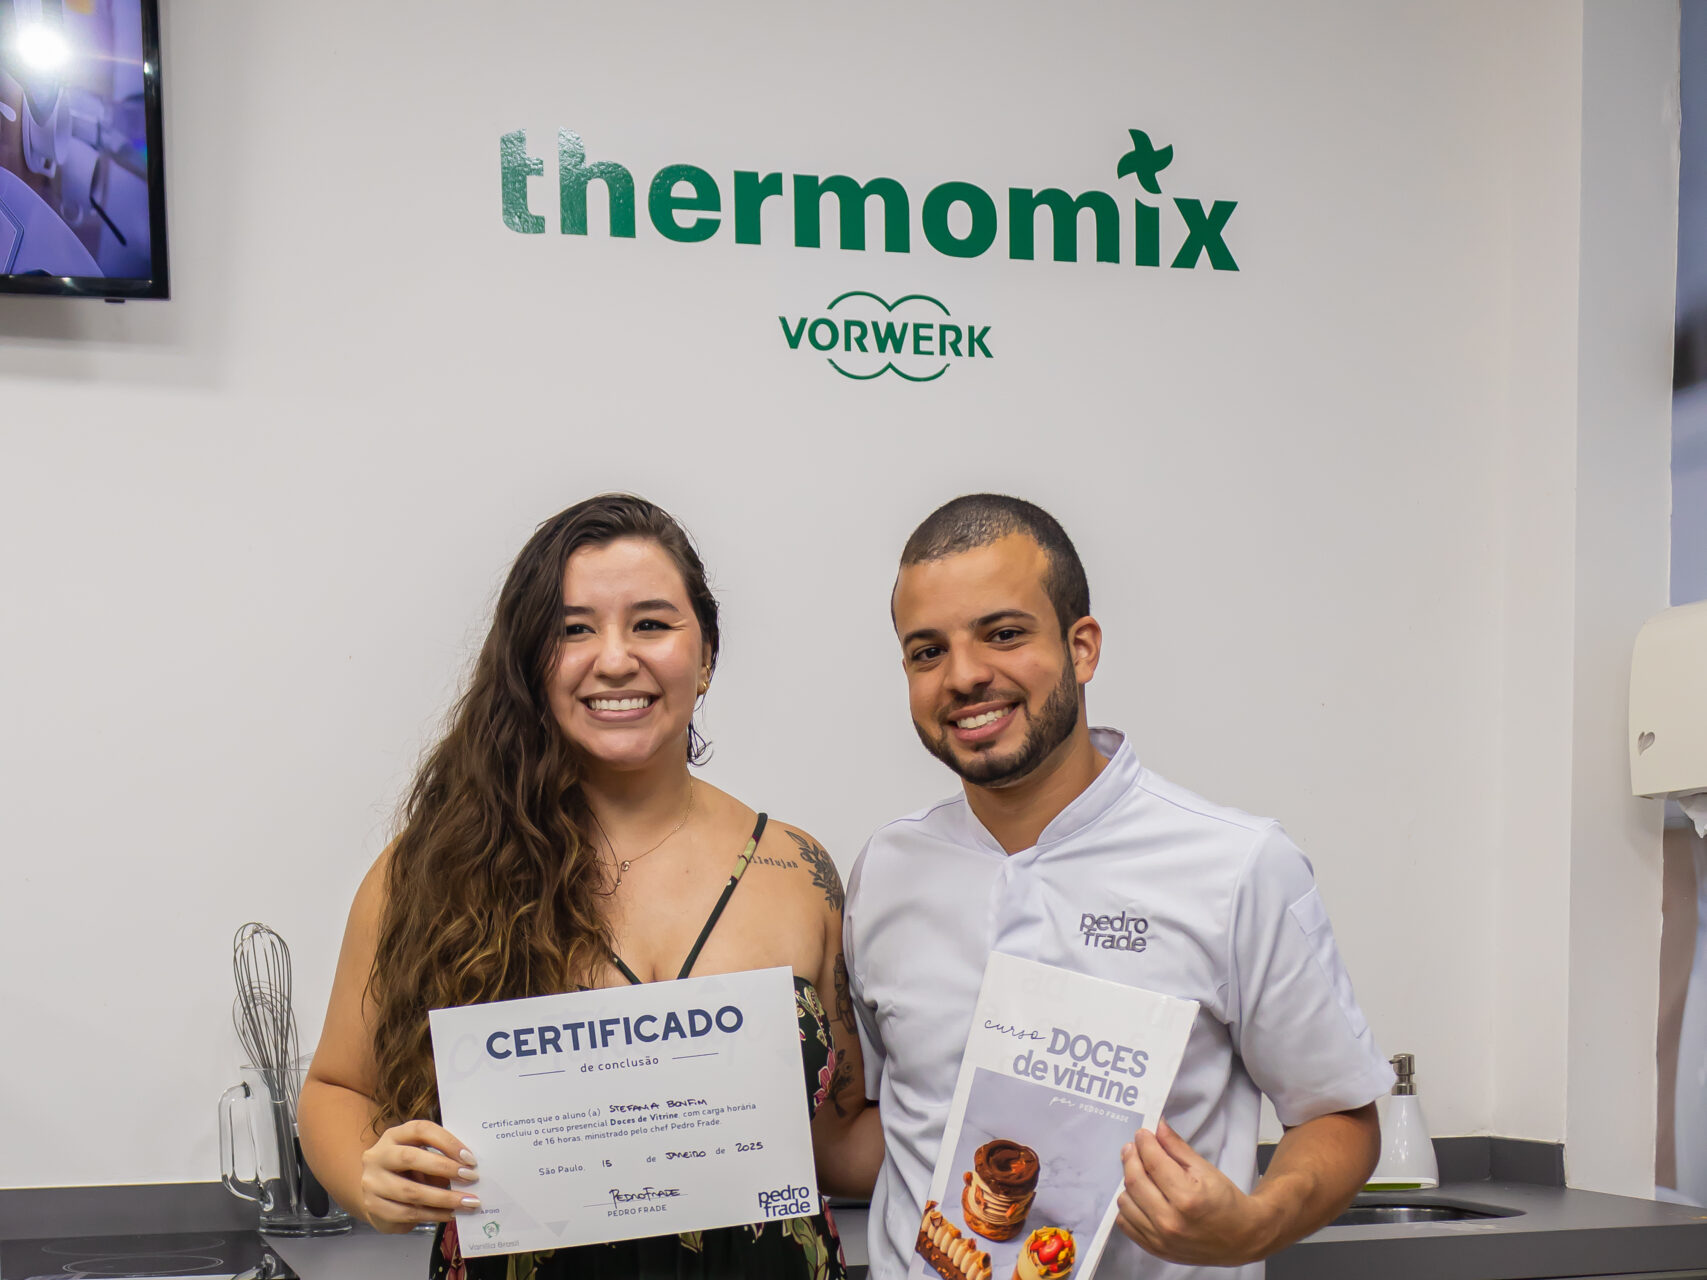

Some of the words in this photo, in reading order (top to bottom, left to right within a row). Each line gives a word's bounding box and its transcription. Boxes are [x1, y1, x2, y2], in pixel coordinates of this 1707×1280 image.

[499, 127, 1240, 272] thermomix
[778, 316, 994, 359] VORWERK
[737, 855, 799, 869] llelujah
[1080, 911, 1148, 934] pedro
[1083, 928, 1147, 952] frade
[486, 1005, 744, 1060] CERTIFICADO
[984, 1019, 1047, 1040] curso
[1046, 1027, 1149, 1078] DOCES
[580, 1062, 594, 1073] de
[597, 1056, 659, 1071] conclusão
[1012, 1049, 1048, 1081] de
[1053, 1062, 1139, 1106] vitrine
[482, 1117, 536, 1130] Certificamos
[537, 1116, 553, 1125] que
[562, 1111, 586, 1121] aluno
[588, 1108, 601, 1118] (a)
[495, 1130, 532, 1140] concluiu
[541, 1125, 565, 1135] curso
[566, 1120, 608, 1133] presencial
[610, 1117, 636, 1126] Doces
[637, 1115, 648, 1123] de
[683, 1109, 700, 1118] com
[702, 1107, 725, 1116] carga
[727, 1103, 757, 1113] horária
[533, 1139, 543, 1147] de
[545, 1137, 555, 1146] 16
[585, 1129, 629, 1141] ministrado
[630, 1127, 648, 1137] pelo
[650, 1124, 669, 1133] chef
[671, 1121, 695, 1130] Pedro
[538, 1167, 556, 1176] São
[601, 1159, 613, 1168] 15
[646, 1155, 656, 1163] de
[715, 1147, 726, 1155] de
[735, 1141, 764, 1153] 2025
[758, 1185, 810, 1208] pedro
[764, 1195, 811, 1218] frade
[607, 1208, 637, 1218] PEDRO
[638, 1204, 668, 1214] FRADE
